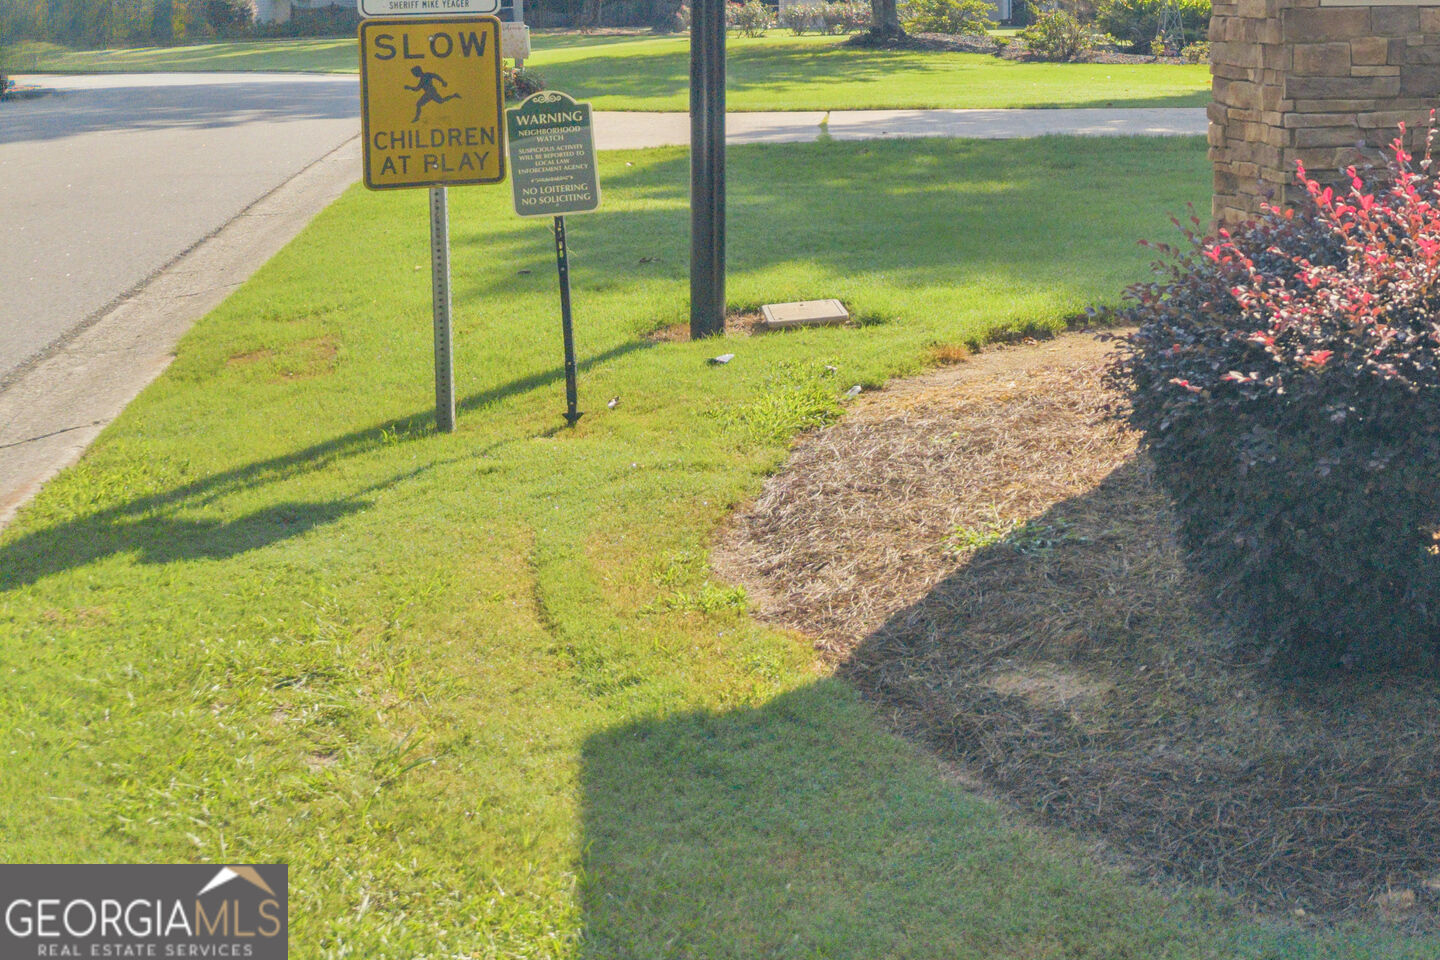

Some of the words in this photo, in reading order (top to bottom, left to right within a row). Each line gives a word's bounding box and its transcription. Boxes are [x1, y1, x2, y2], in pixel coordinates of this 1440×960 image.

[389, 0, 419, 9] SHERIFF
[422, 0, 439, 8] MIKE
[442, 0, 470, 8] YEAGER
[374, 31, 488, 61] SLOW
[516, 111, 583, 125] WARNING
[518, 126, 581, 136] NEIGHBORHOOD
[373, 126, 495, 151] CHILDREN
[380, 155, 411, 175] AT
[424, 151, 489, 173] PLAY
[522, 187, 537, 195] NO
[540, 183, 588, 194] LOITERING
[539, 192, 591, 204] SOLICITING
